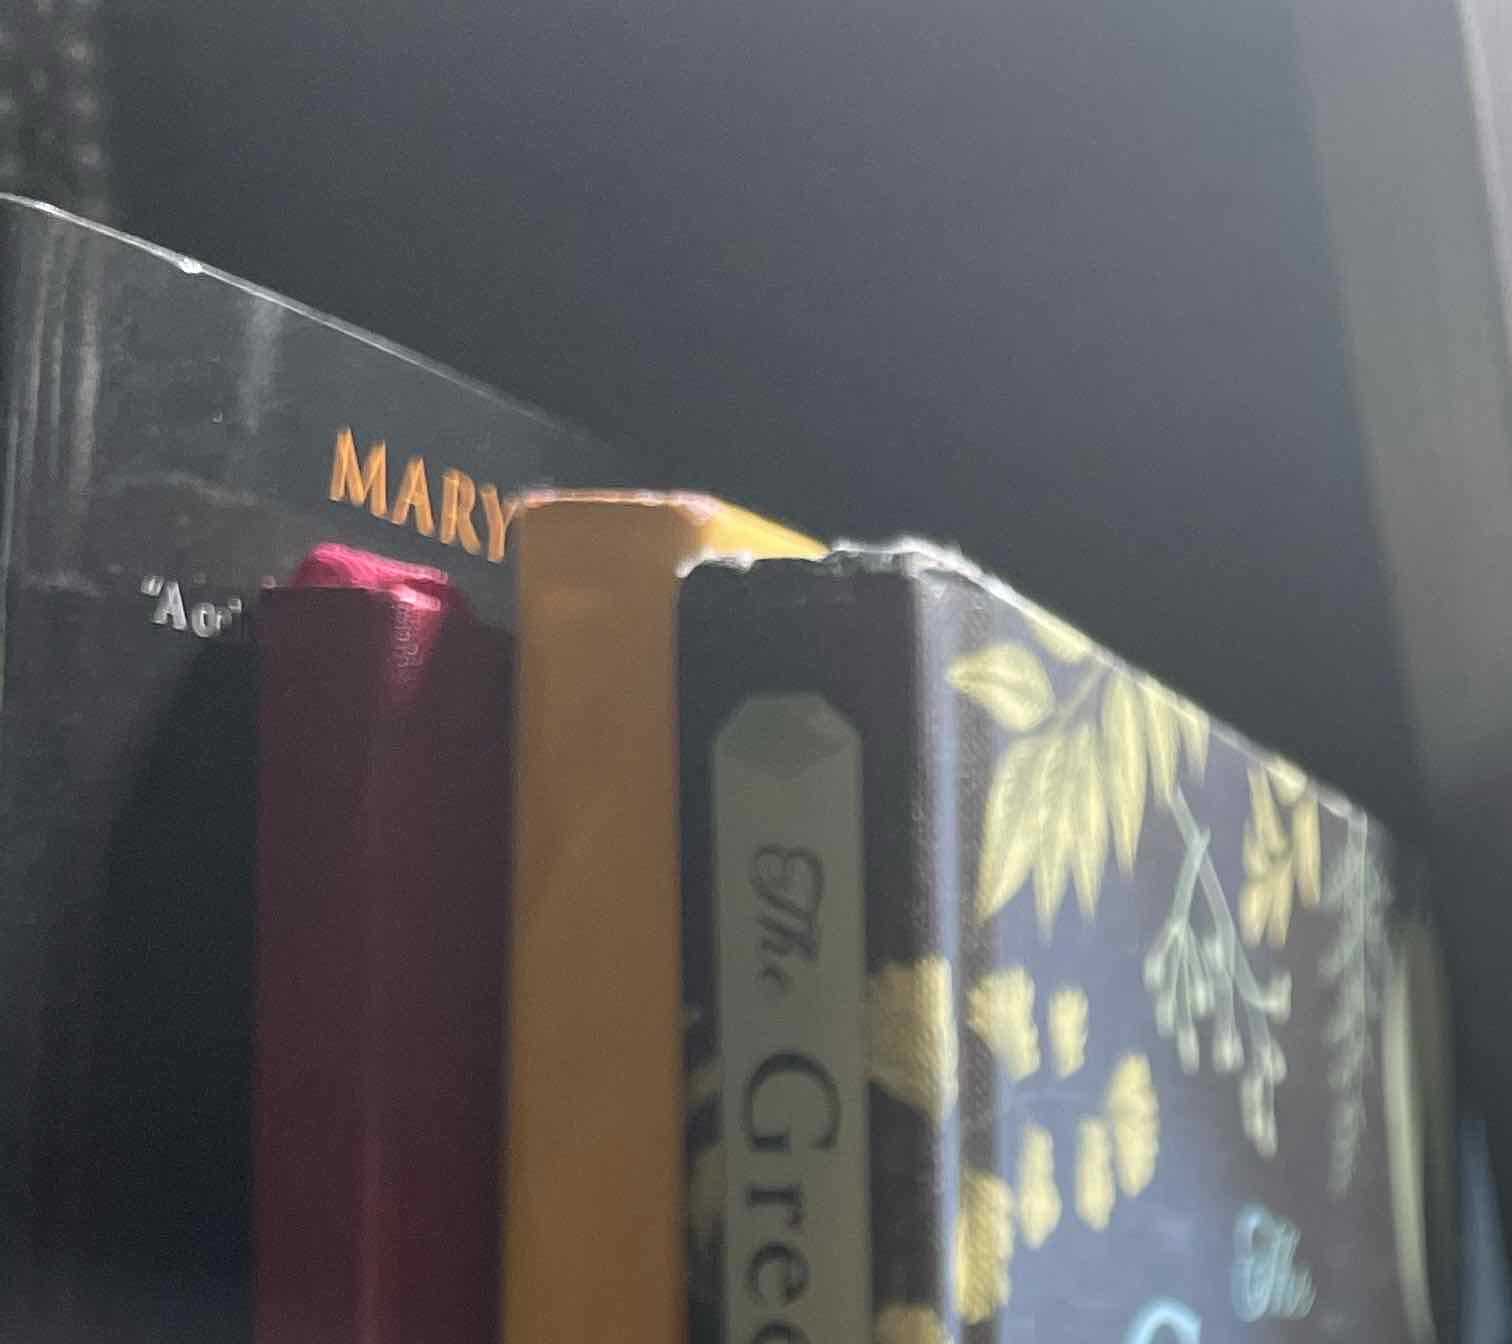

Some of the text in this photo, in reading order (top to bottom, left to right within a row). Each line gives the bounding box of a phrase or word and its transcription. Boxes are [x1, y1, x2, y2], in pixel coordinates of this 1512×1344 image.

[329, 424, 519, 563] MARY
[748, 842, 825, 993] The
[1232, 1204, 1317, 1322] The
